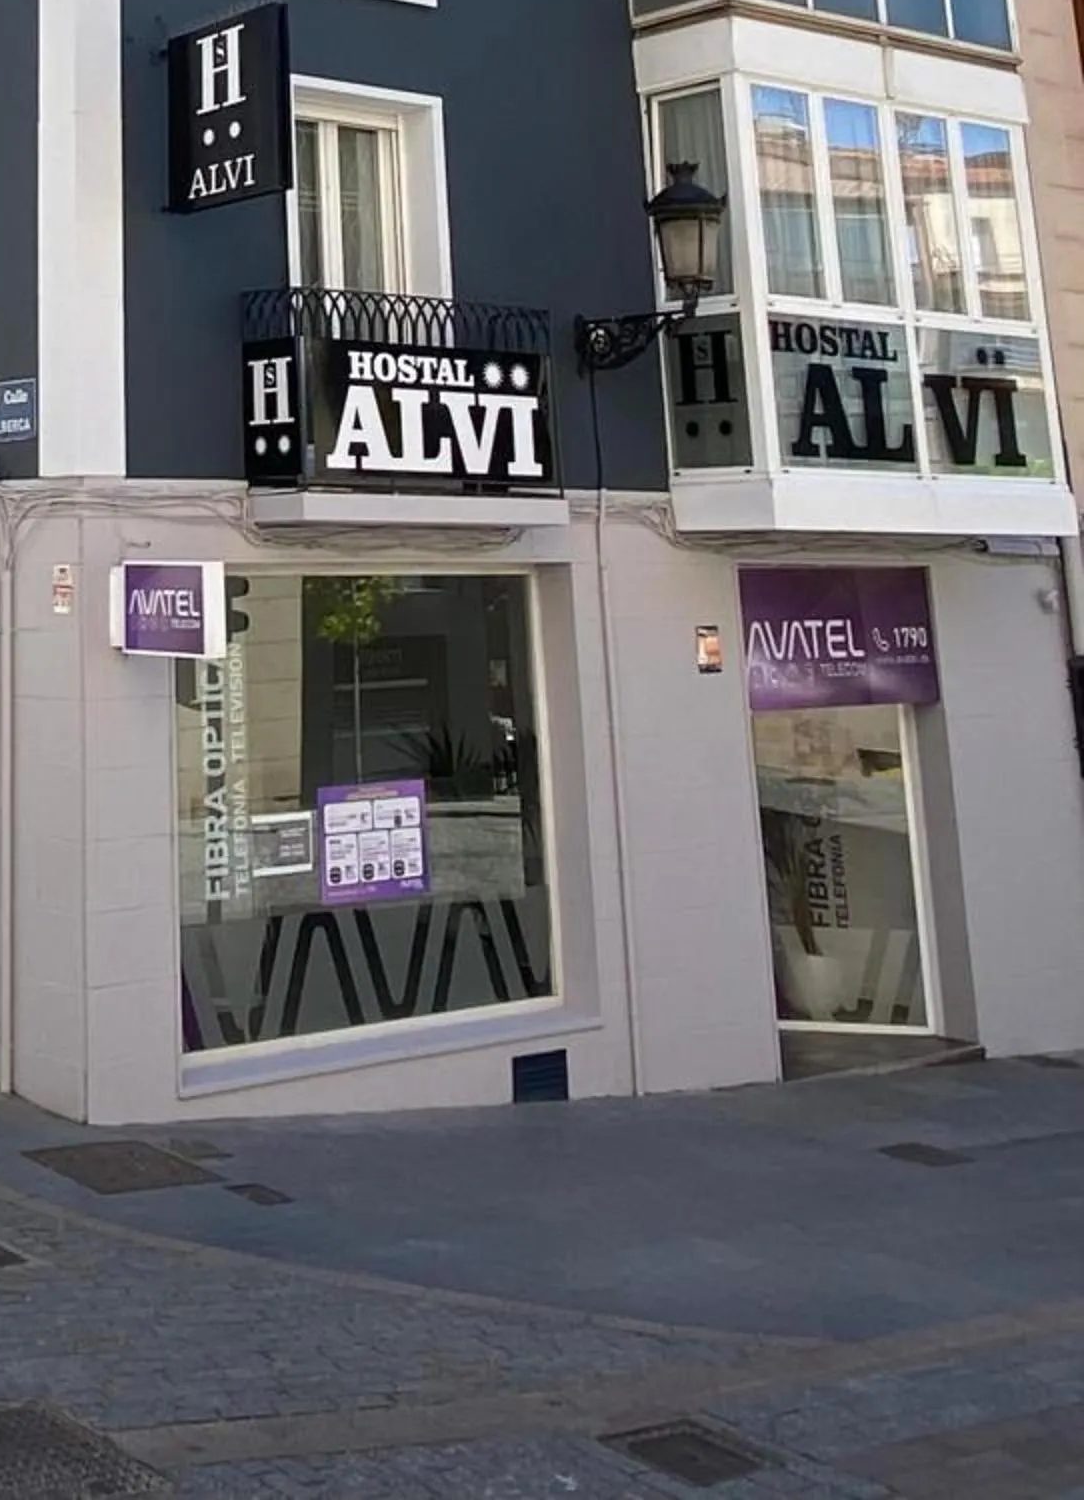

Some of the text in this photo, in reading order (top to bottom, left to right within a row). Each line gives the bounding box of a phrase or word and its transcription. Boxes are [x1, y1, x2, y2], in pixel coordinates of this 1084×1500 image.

[196, 23, 246, 115] H
[188, 153, 256, 199] ALVI
[349, 351, 475, 386] HOSTAL
[670, 329, 738, 407] H
[769, 320, 897, 362] HOSTAL
[247, 355, 295, 427] H
[792, 363, 1026, 466] ALVI
[326, 385, 543, 477] ALVI
[129, 588, 201, 617] AVATEL
[748, 619, 865, 660] AVATEL
[893, 627, 928, 649] 1790
[229, 642, 251, 900] TELEFONIA TELEVISION
[203, 788, 231, 901] FIBRA
[804, 837, 832, 928] FIBRA
